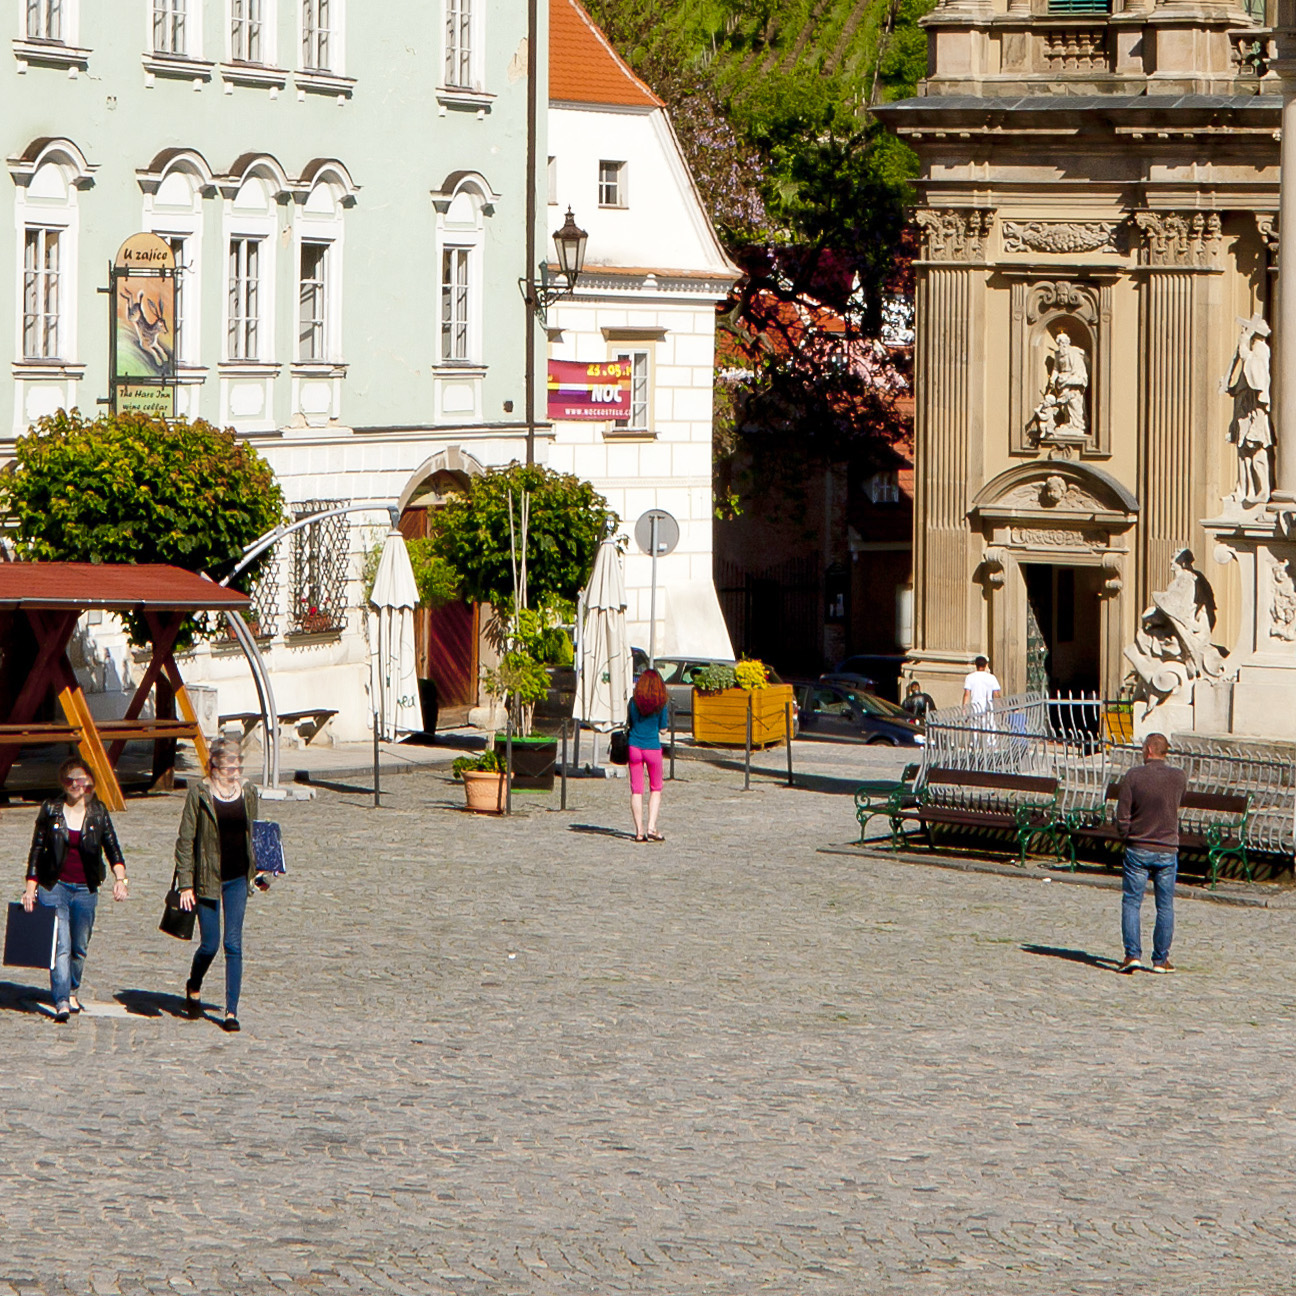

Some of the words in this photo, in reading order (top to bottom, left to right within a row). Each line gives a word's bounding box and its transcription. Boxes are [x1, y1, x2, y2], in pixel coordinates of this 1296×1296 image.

[124, 248, 133, 260] U
[135, 248, 168, 262] zajíce
[119, 389, 133, 398] The
[134, 389, 154, 399] Hare
[591, 385, 622, 402] NOC
[142, 402, 168, 411] cellar
